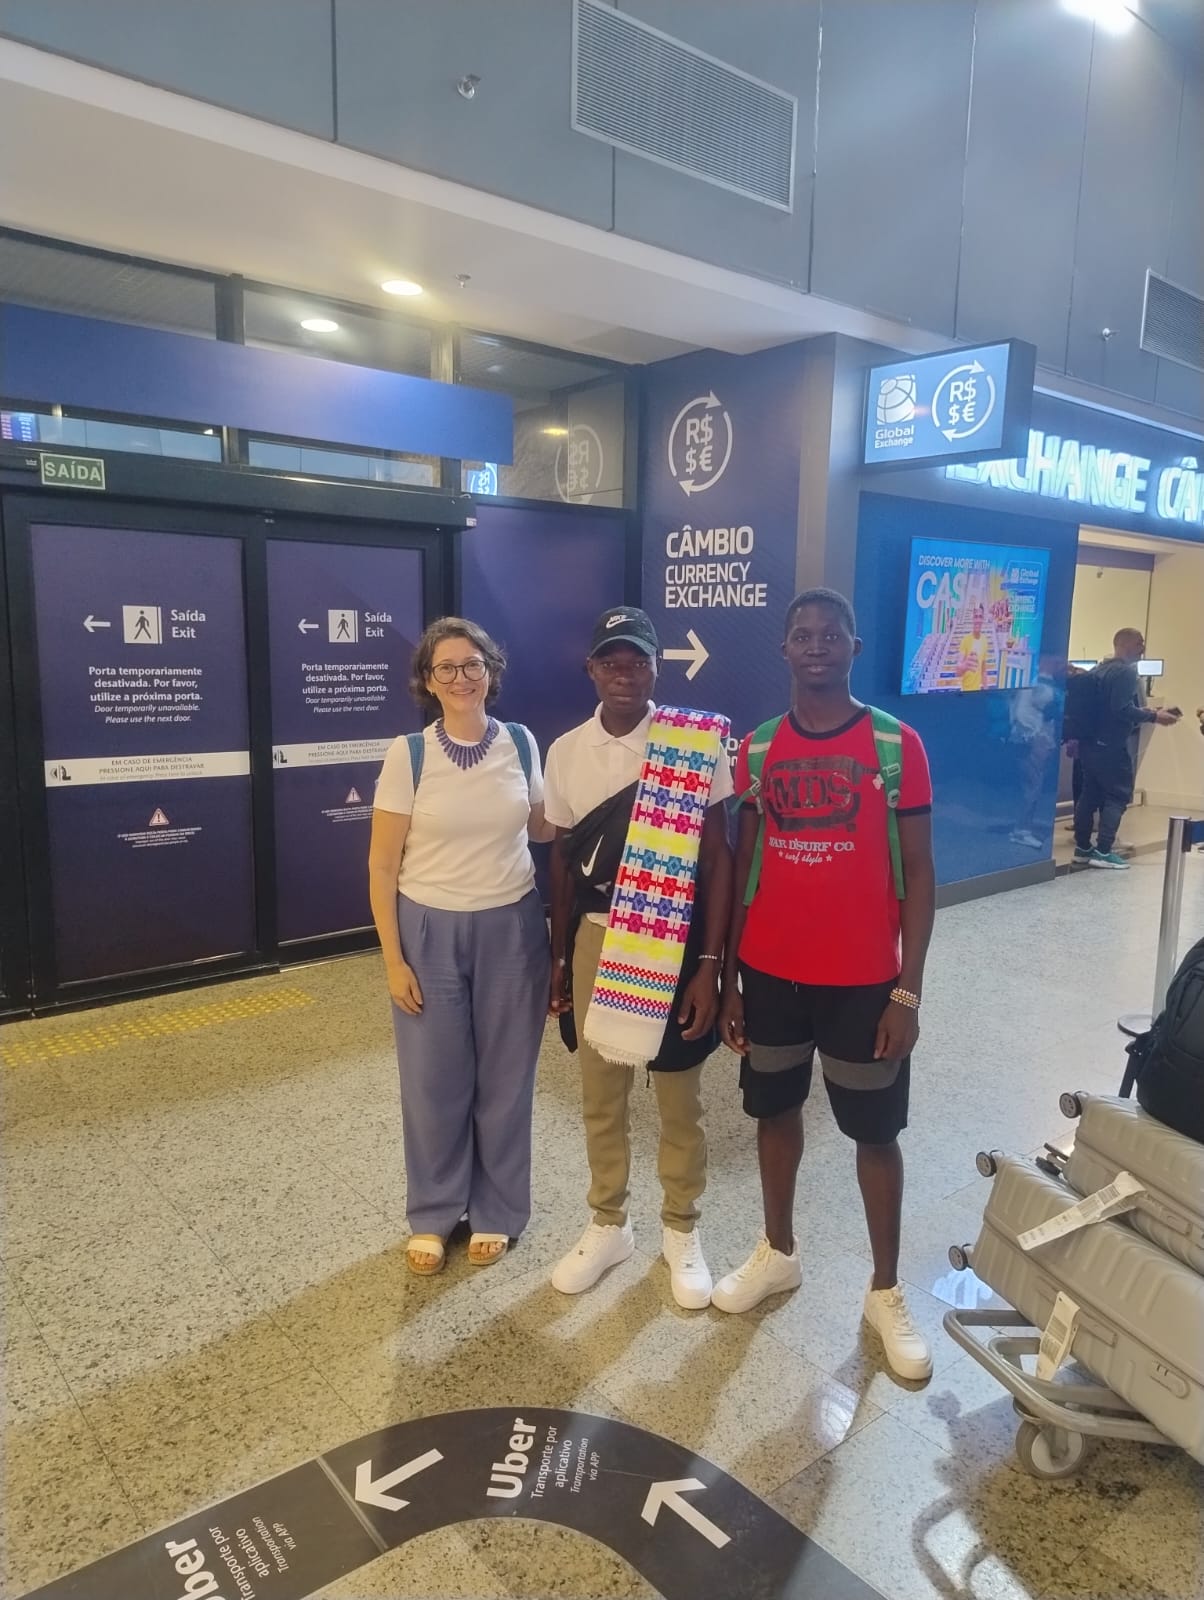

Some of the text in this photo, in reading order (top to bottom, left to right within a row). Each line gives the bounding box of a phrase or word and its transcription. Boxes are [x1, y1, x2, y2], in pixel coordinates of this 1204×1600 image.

[949, 377, 977, 403] R$
[685, 413, 713, 446] R$
[875, 425, 915, 440] Global
[874, 436, 914, 448] Exchange
[44, 461, 102, 481] SAÍDA
[1157, 456, 1204, 523] CÂ
[666, 525, 754, 558] CÂMBIO
[665, 561, 751, 585] CURRENCY
[918, 555, 990, 569] DISCOVER MORE WITH
[665, 583, 768, 608] EXCHANGE
[171, 609, 206, 622] Saída
[364, 612, 393, 623] Saída
[172, 627, 196, 639] Exit
[365, 627, 384, 638] Exit
[88, 666, 203, 678] Porta temporariamente
[301, 662, 389, 672] Porta temporariamente
[305, 673, 385, 682] desativada. Por favor,
[94, 679, 198, 689] desativada. Por favor,
[302, 685, 327, 694] utilize
[334, 685, 365, 695] próxima
[366, 685, 389, 695] porta.
[90, 692, 203, 704] utilize a próxima porta.
[94, 705, 113, 713] Door
[114, 704, 157, 714] temporarily
[105, 715, 129, 724] Please
[143, 715, 155, 723] the
[156, 715, 172, 723] next
[173, 714, 192, 722] door.
[771, 772, 851, 809] MDS
[785, 852, 823, 867] surf style
[486, 1417, 537, 1498] Uber
[530, 1425, 558, 1498] Transporte por
[554, 1439, 573, 1488] aplicativo
[570, 1437, 589, 1493] Transportation
[589, 1451, 600, 1481] via APP
[252, 1516, 290, 1573] Transportation
[272, 1522, 296, 1550] via APP
[208, 1526, 256, 1600] ransporte por
[235, 1528, 272, 1578] aplicativo
[165, 1538, 227, 1600] ber
